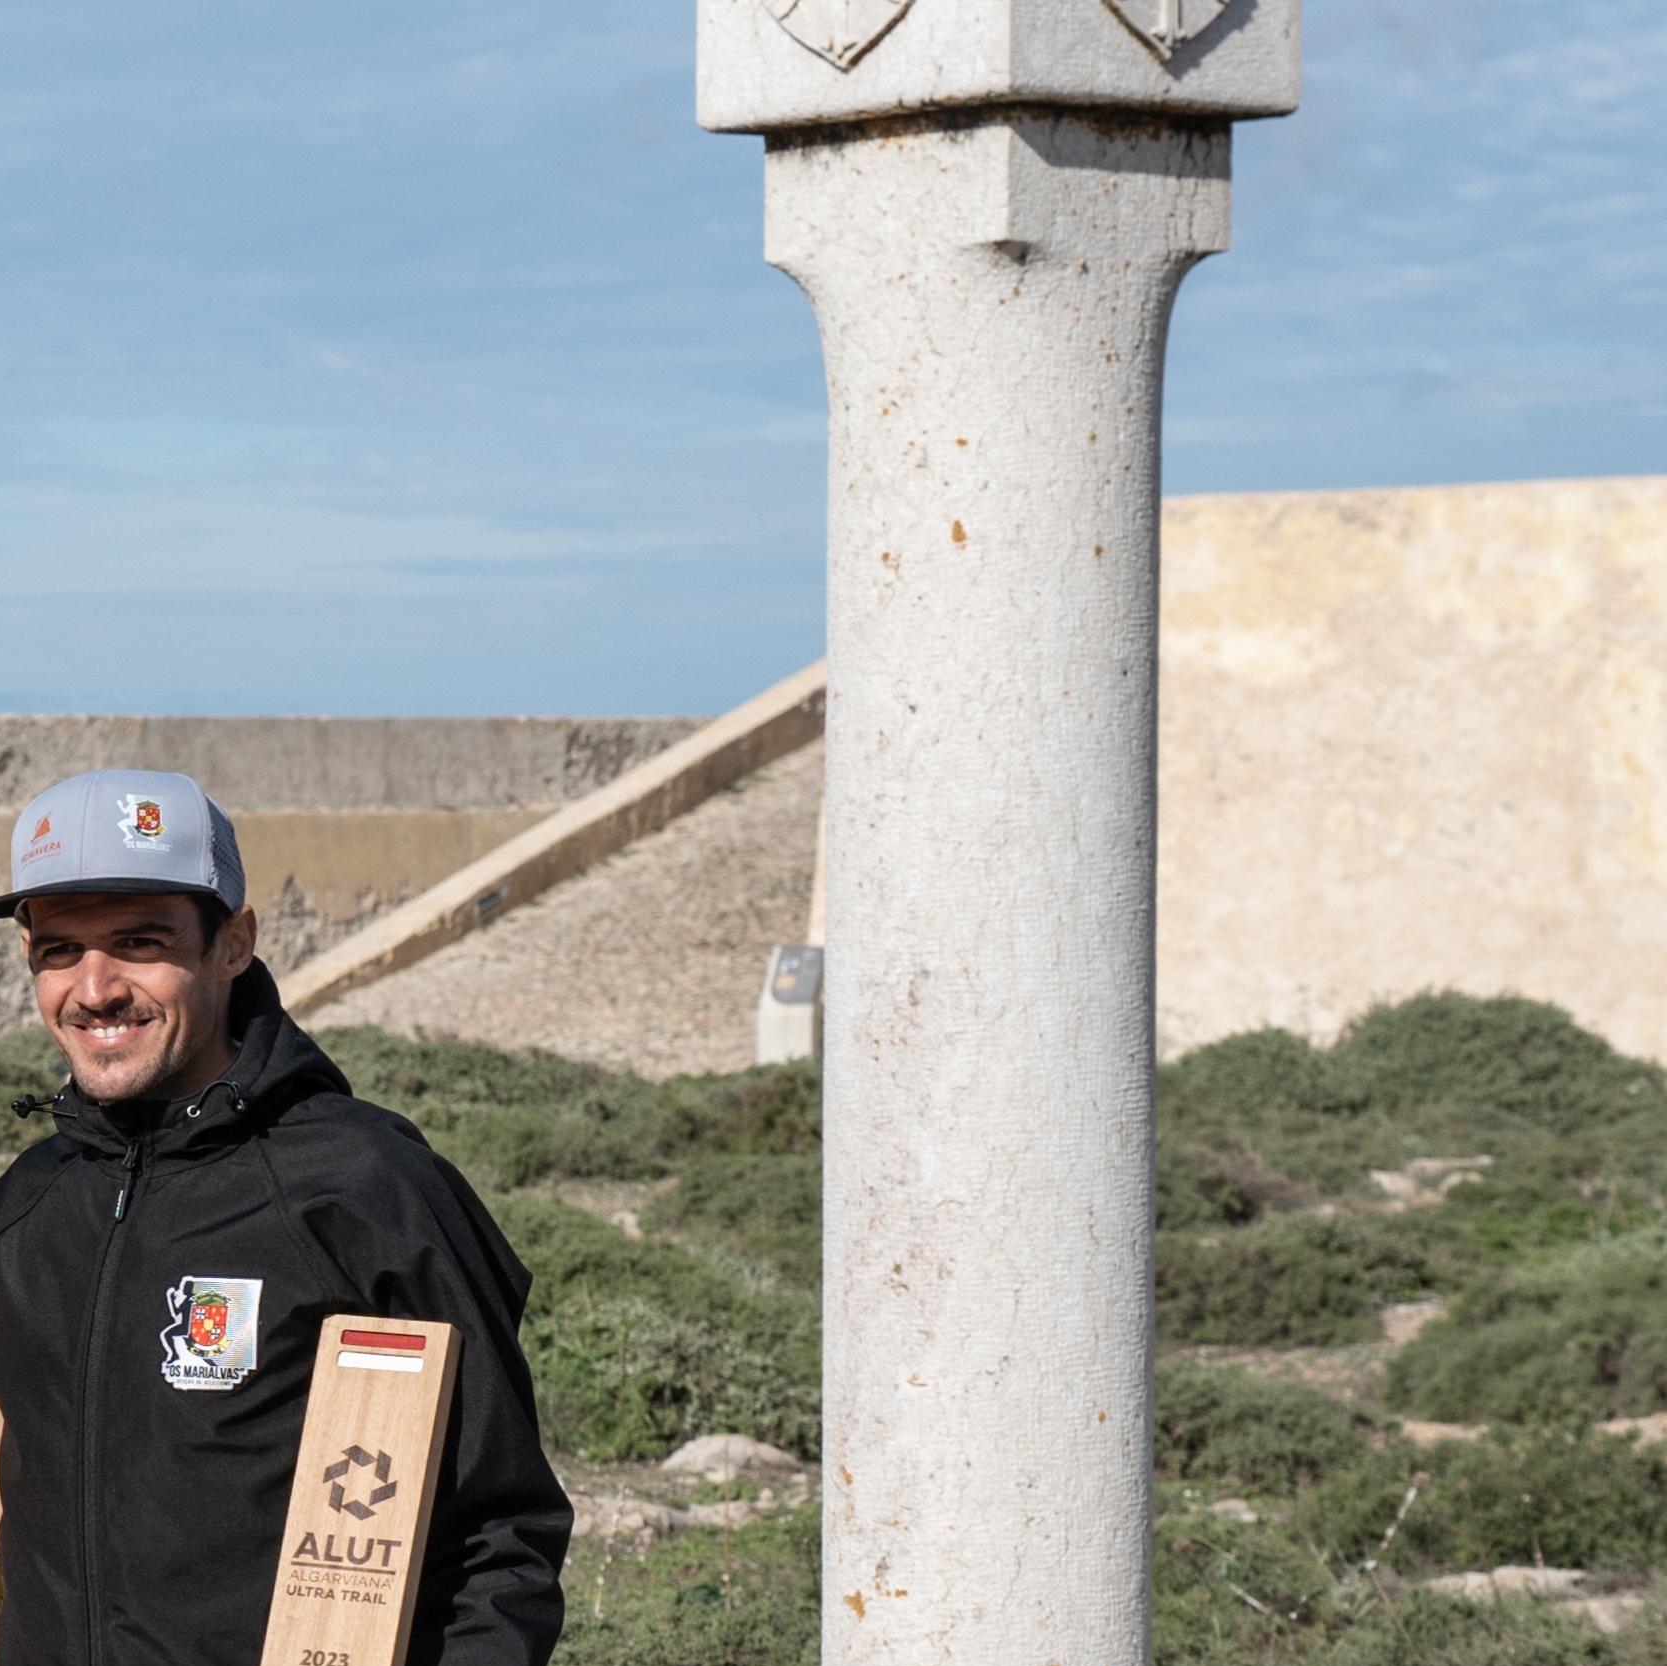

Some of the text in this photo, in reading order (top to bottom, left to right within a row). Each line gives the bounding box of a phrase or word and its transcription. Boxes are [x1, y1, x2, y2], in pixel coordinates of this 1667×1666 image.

[292, 1531, 402, 1568] ALUT
[289, 1569, 392, 1590] ALGARVIANA
[286, 1584, 387, 1605] ULTRA TRAIL
